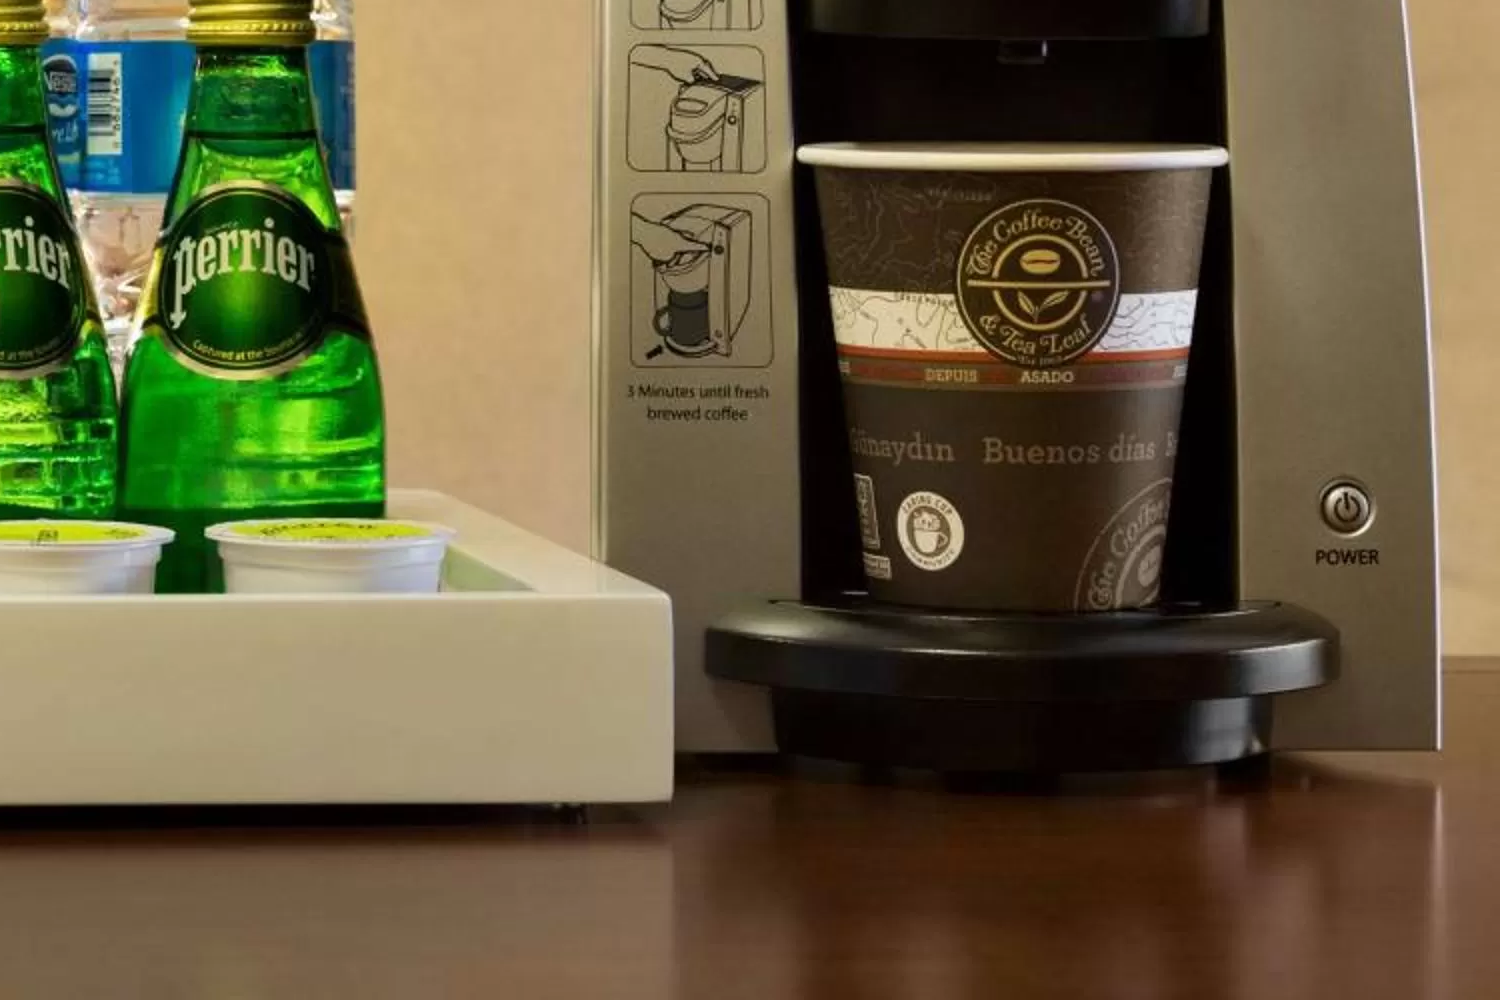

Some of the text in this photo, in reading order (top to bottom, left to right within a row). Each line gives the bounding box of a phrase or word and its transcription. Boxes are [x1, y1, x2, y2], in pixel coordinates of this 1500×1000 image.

[965, 208, 1106, 277] The Coffee Bean
[169, 217, 316, 331] perrier
[1000, 325, 1037, 356] Tea
[1039, 313, 1092, 356] Leaf
[236, 351, 246, 361] at
[1020, 370, 1075, 384] ASADO
[627, 384, 770, 399] 3 Minutes until fresh
[646, 404, 749, 421] brewed coffee
[982, 436, 1102, 465] Buenos
[1315, 548, 1381, 566] POWER
